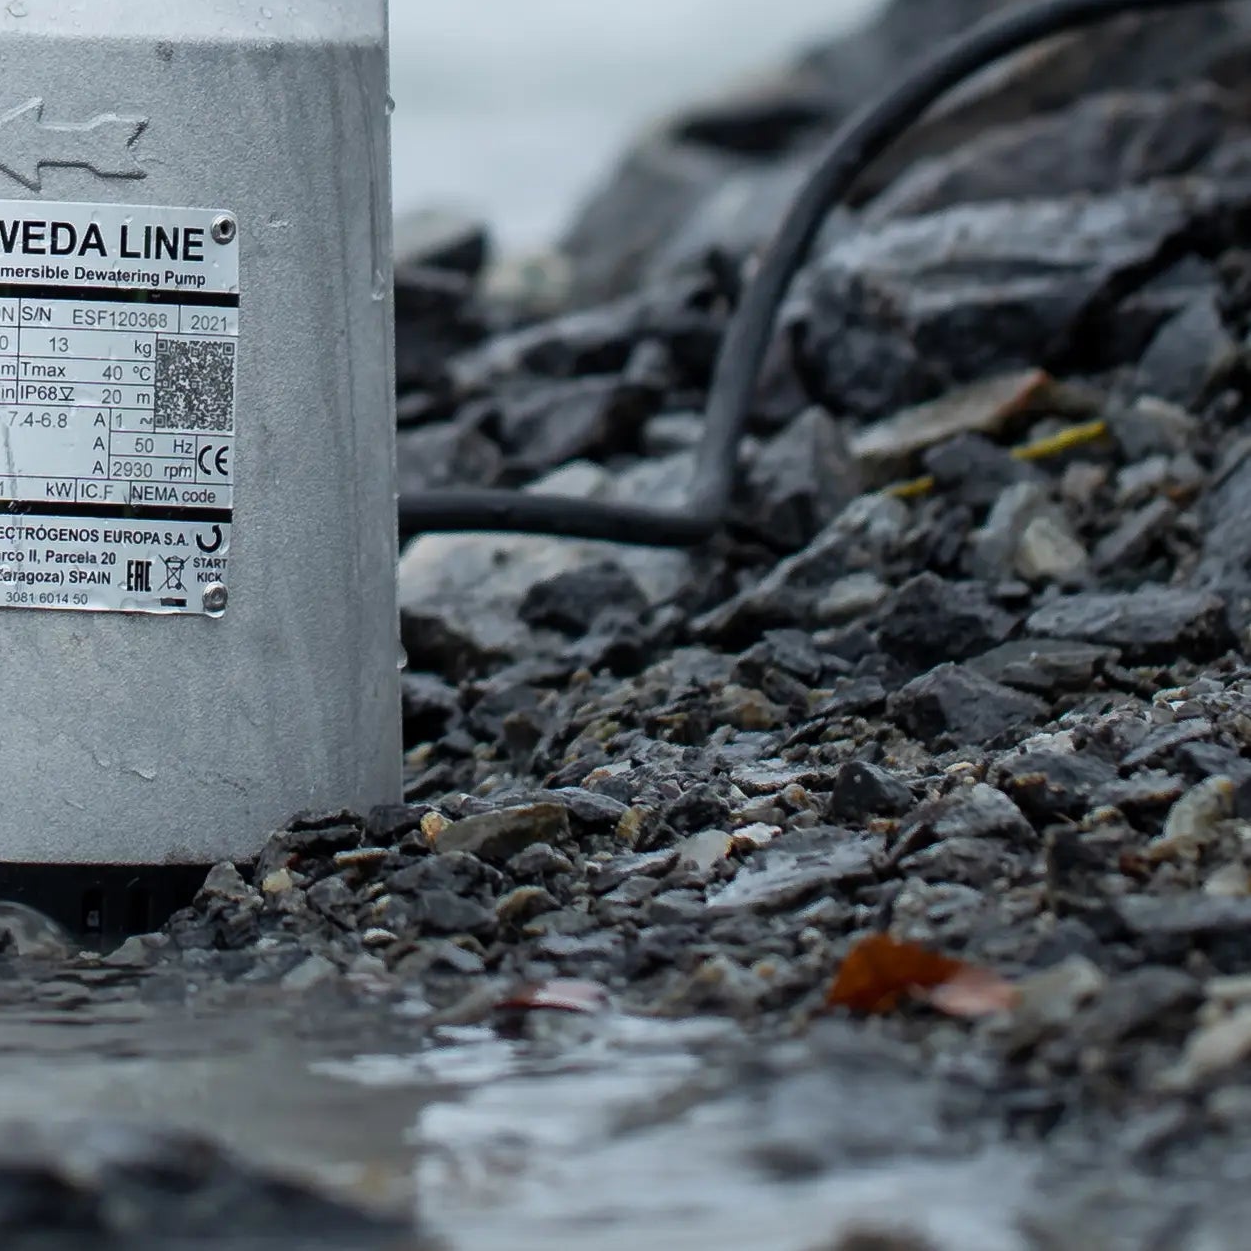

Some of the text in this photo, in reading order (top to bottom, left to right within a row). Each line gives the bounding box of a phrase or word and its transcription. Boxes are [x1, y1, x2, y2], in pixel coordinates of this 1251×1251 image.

[119, 224, 205, 262] LINE
[74, 266, 160, 286] Dewatering
[165, 270, 206, 288] Pump
[21, 306, 168, 329] S/N ESF120368
[190, 315, 228, 331] 2021
[49, 337, 152, 358] 13 kg
[1, 363, 16, 376] m
[21, 361, 66, 378] Tmax
[102, 365, 123, 381] 40
[101, 389, 123, 404] 20
[136, 392, 151, 405] m
[94, 412, 106, 428] A
[93, 436, 105, 451] A
[134, 438, 194, 454] 50 Hz
[92, 460, 105, 475] A
[112, 462, 193, 480] 2930 rpm
[46, 482, 73, 497] kW
[131, 484, 216, 504] NEMA code
[103, 531, 161, 546] EUROPA
[164, 532, 190, 547] S.A.
[45, 550, 98, 565] Parcela
[101, 552, 116, 566] 20
[192, 557, 229, 569] START
[68, 571, 112, 585] SPAIN
[197, 571, 223, 584] KICK
